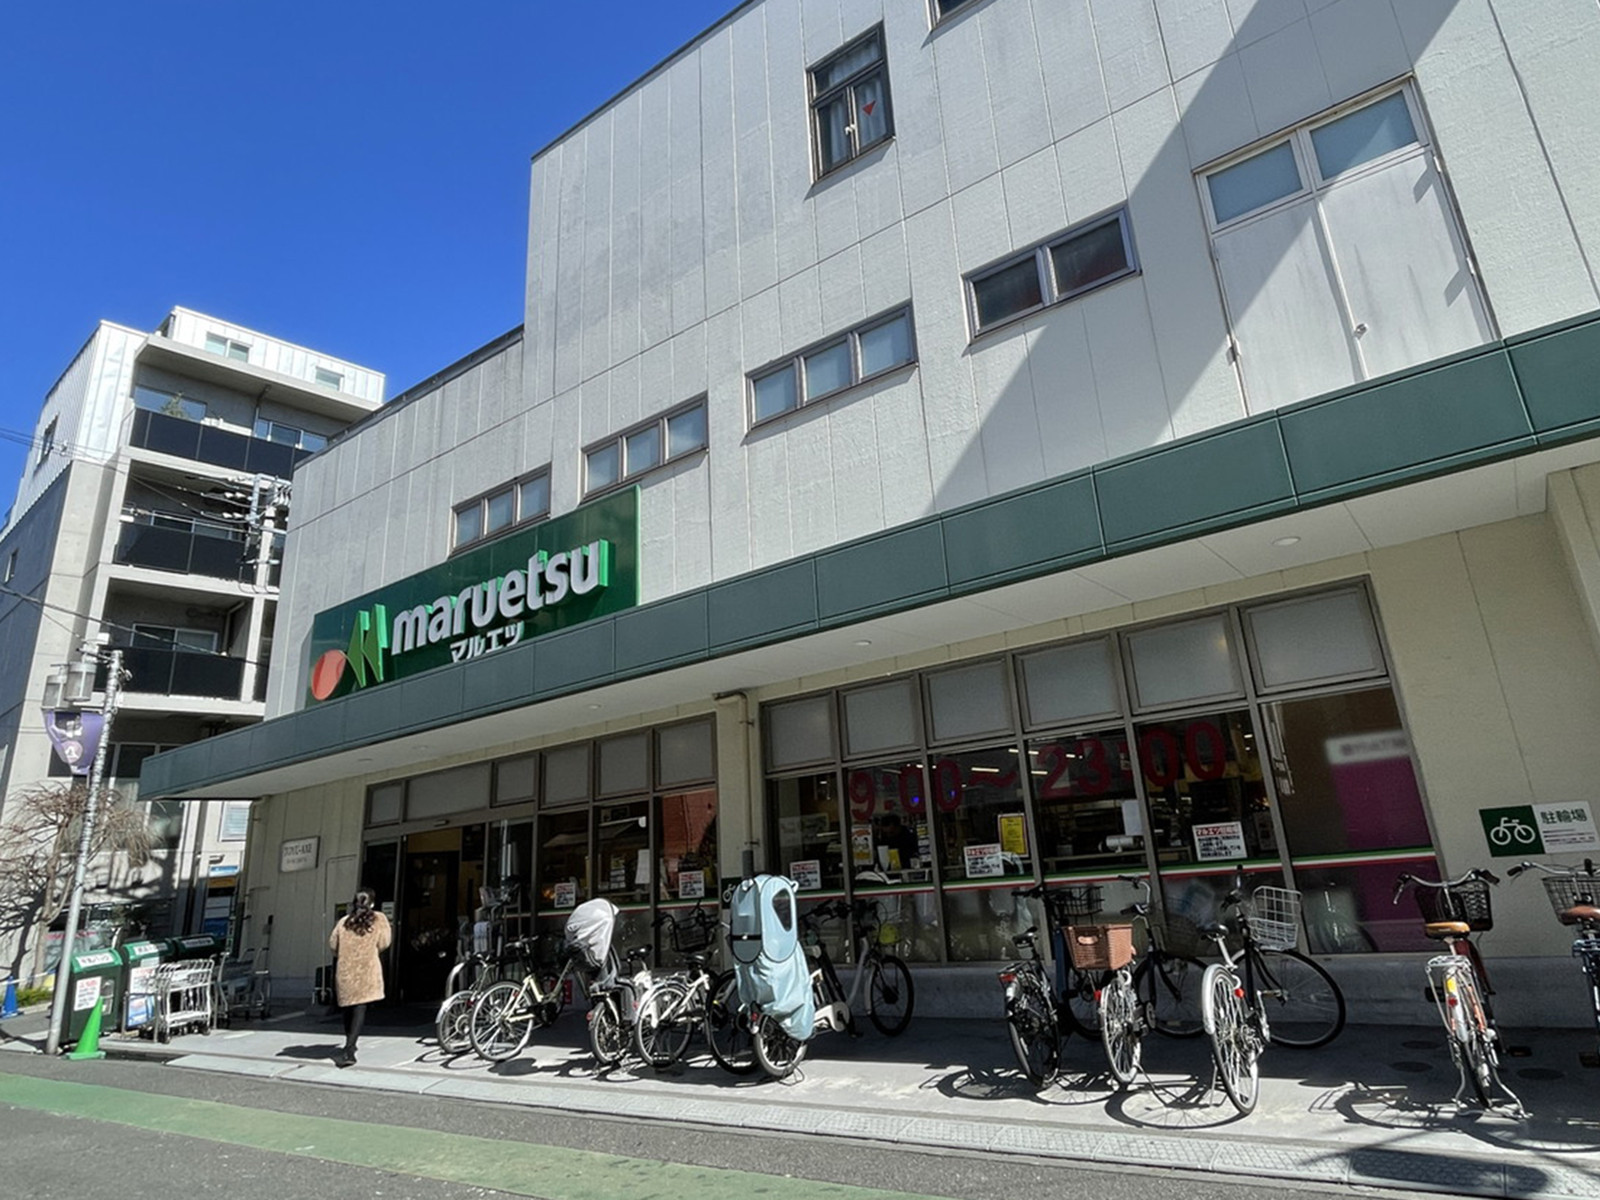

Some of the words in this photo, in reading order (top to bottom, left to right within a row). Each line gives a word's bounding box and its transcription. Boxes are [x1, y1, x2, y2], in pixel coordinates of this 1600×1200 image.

[391, 539, 608, 655] maruetsu
[450, 622, 524, 663] マルエツ
[1541, 808, 1587, 825] 駐輪場
